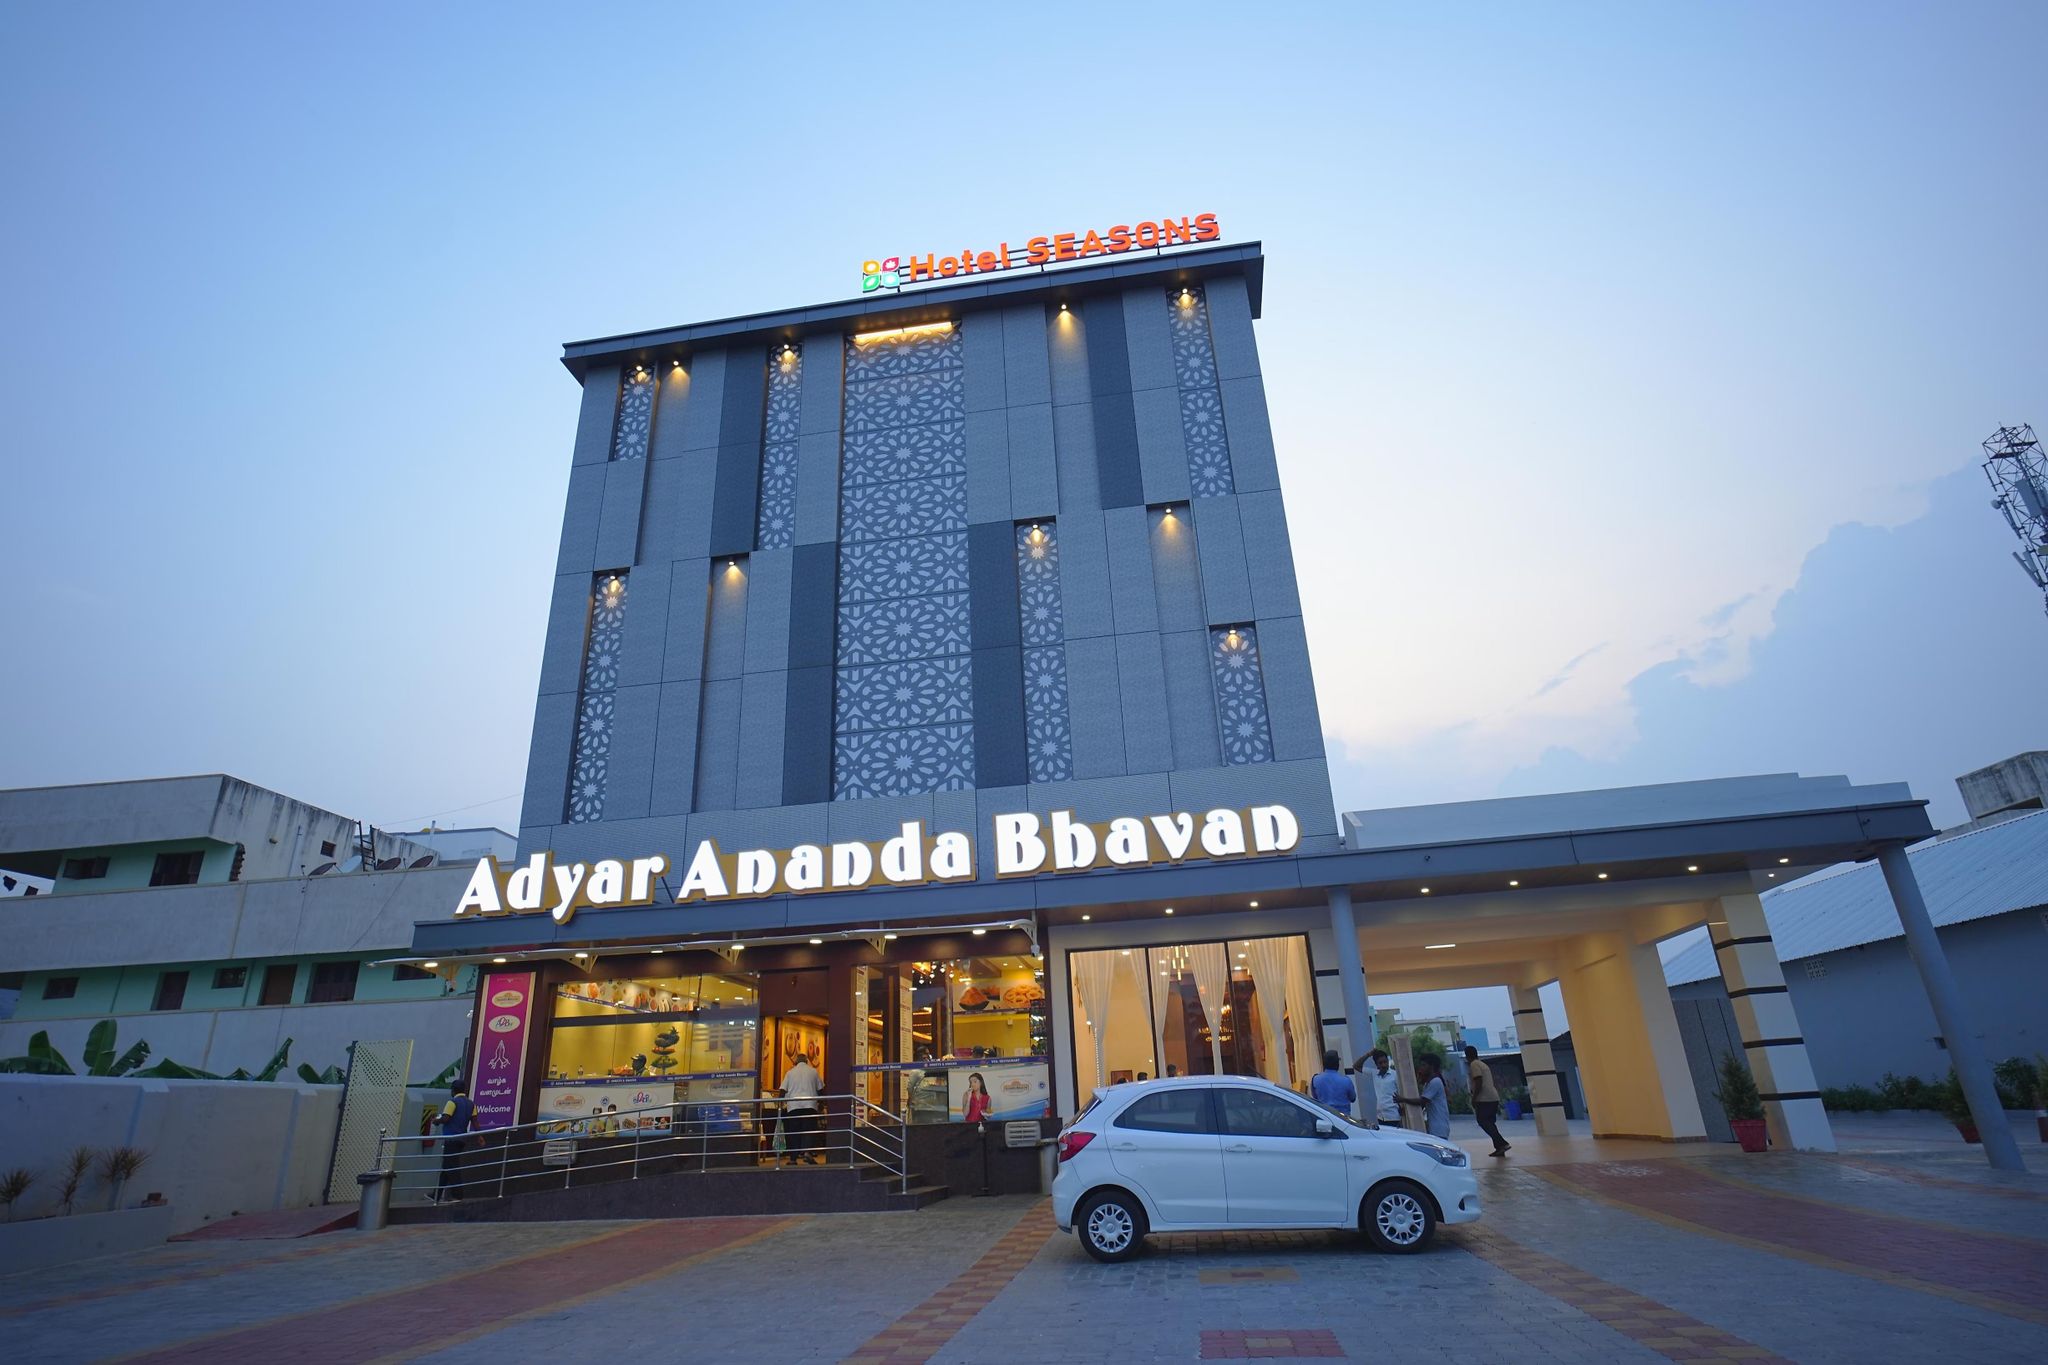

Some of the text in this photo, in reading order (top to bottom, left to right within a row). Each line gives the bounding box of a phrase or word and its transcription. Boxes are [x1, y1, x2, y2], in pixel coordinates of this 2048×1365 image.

[909, 213, 1221, 281] Hotel SEASONS
[455, 803, 1300, 922] Adyar Ananda Bhavan
[477, 1104, 511, 1113] Welcome
